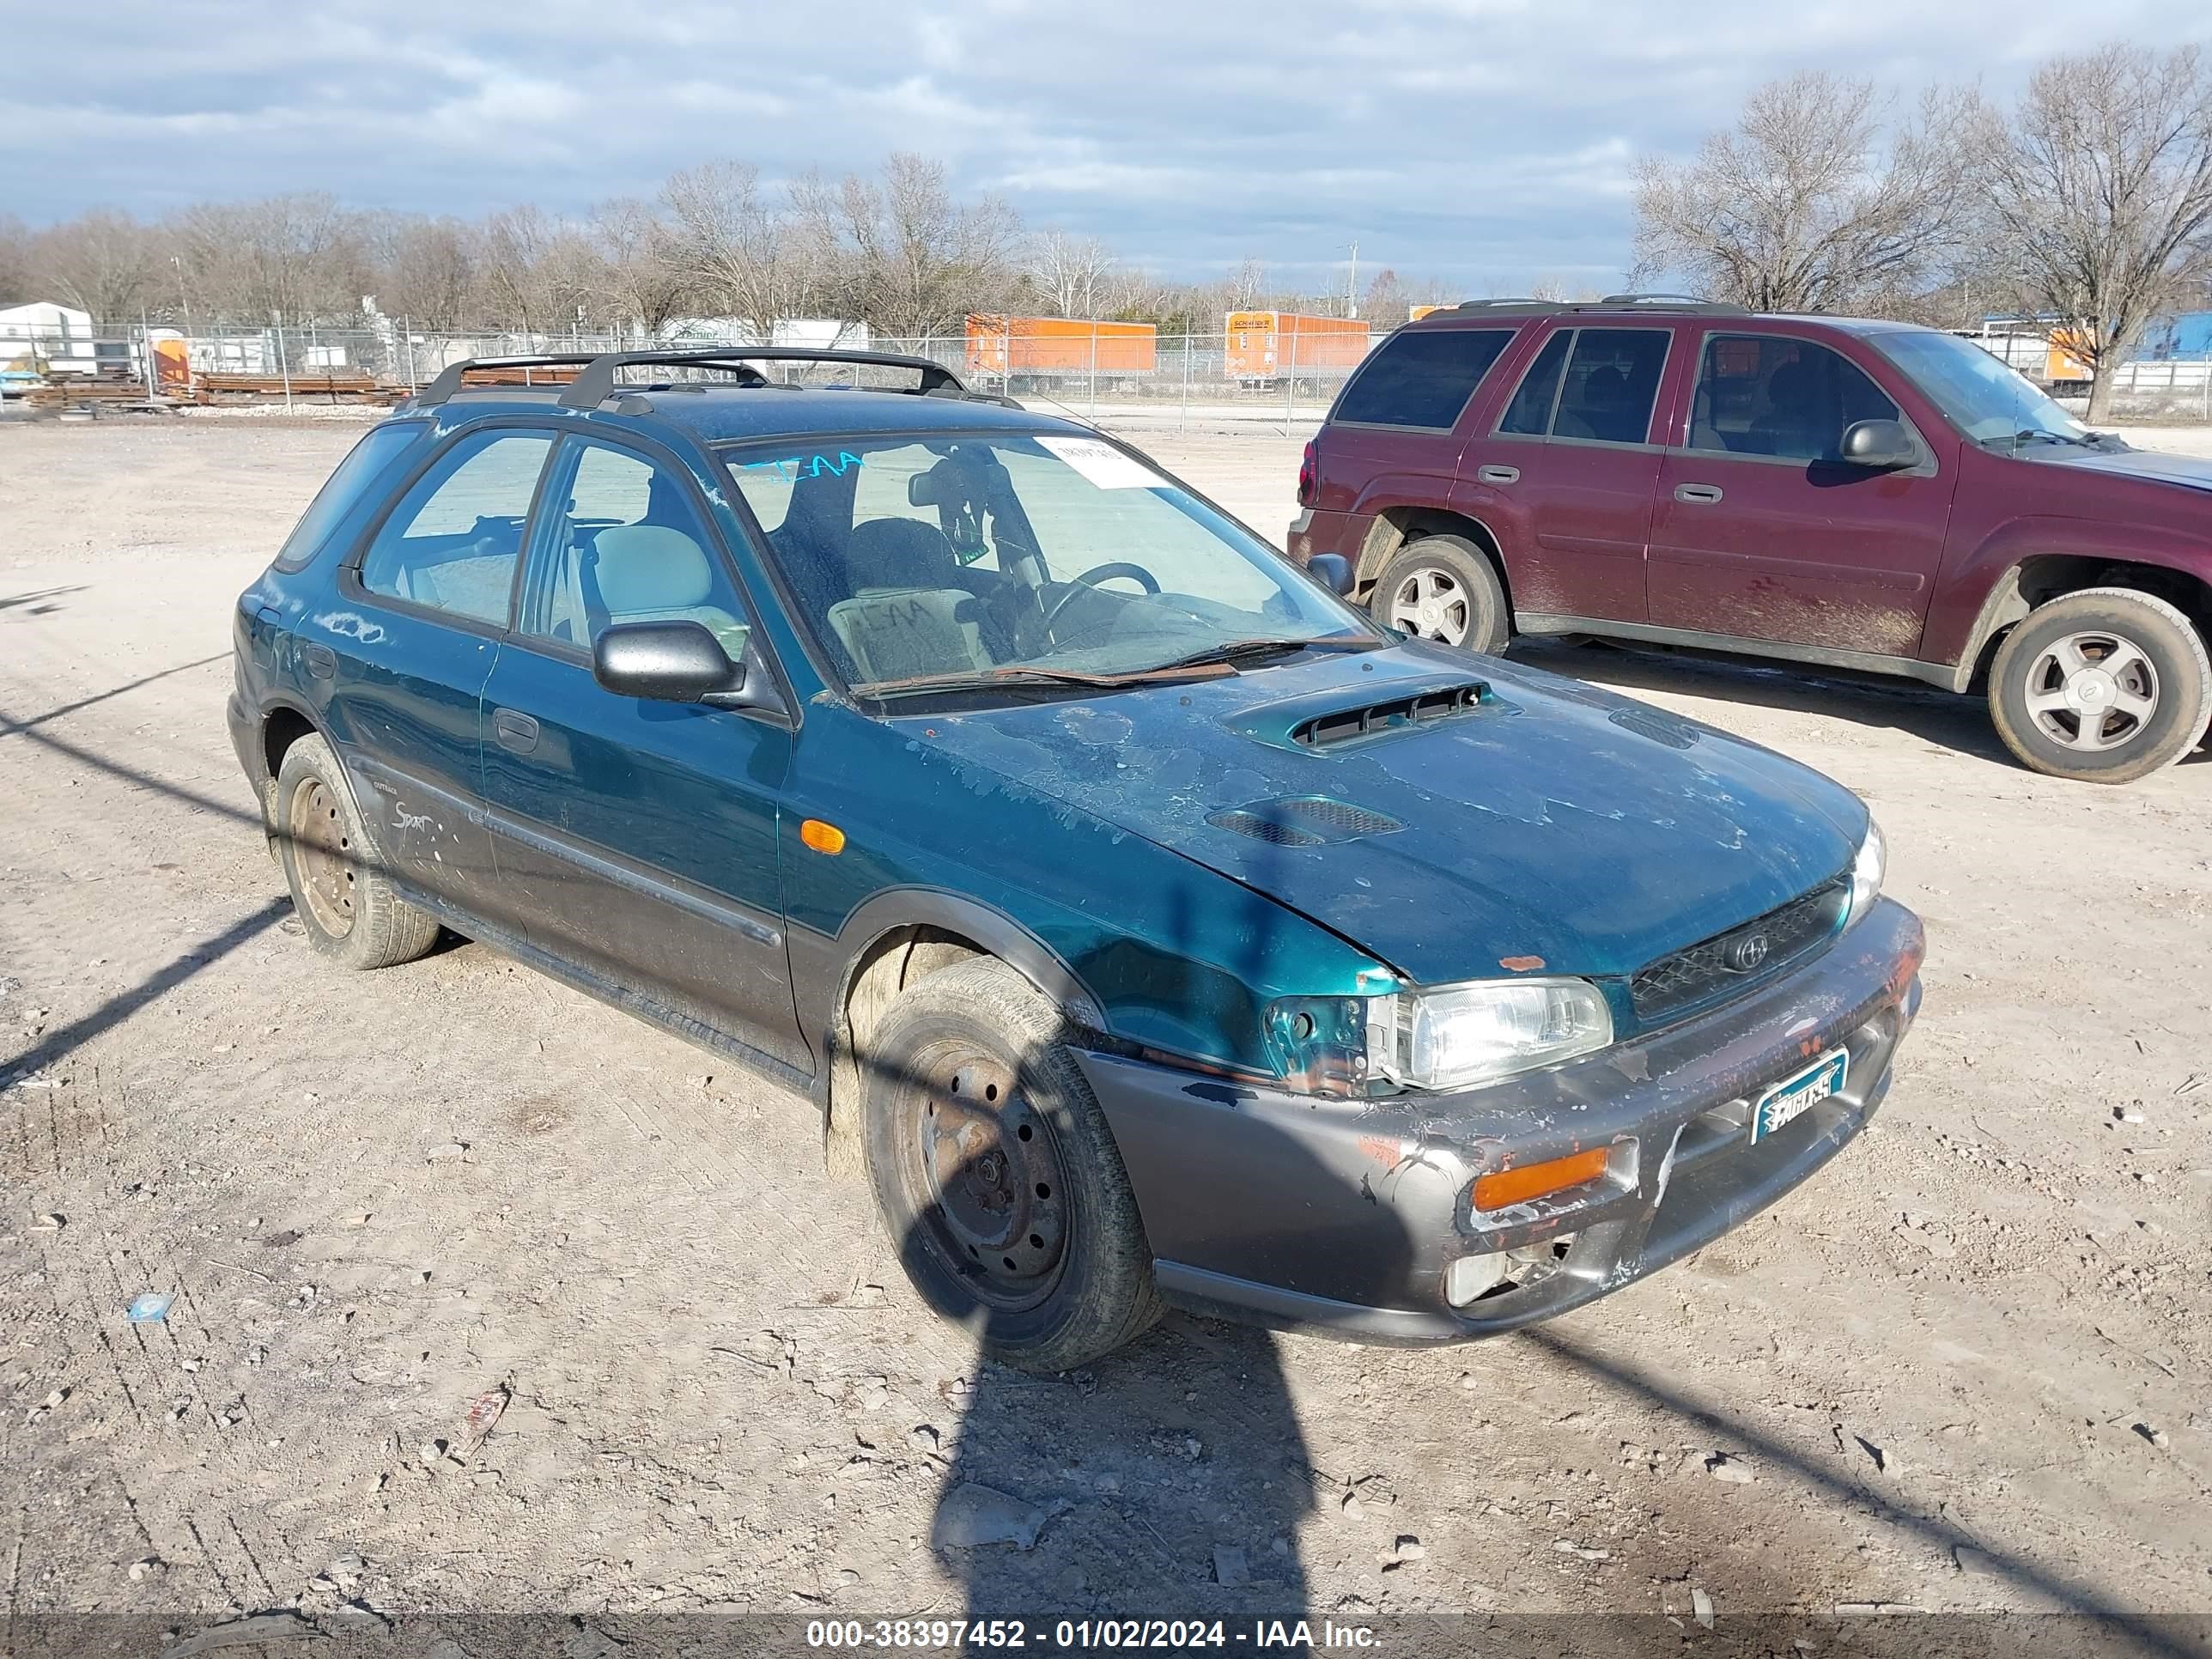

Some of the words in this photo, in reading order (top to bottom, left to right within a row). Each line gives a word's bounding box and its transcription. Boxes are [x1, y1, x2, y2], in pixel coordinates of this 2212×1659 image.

[742, 451, 865, 483] IAA
[373, 781, 398, 795] OUTBACK
[1768, 1070, 1834, 1133] EAGLES
